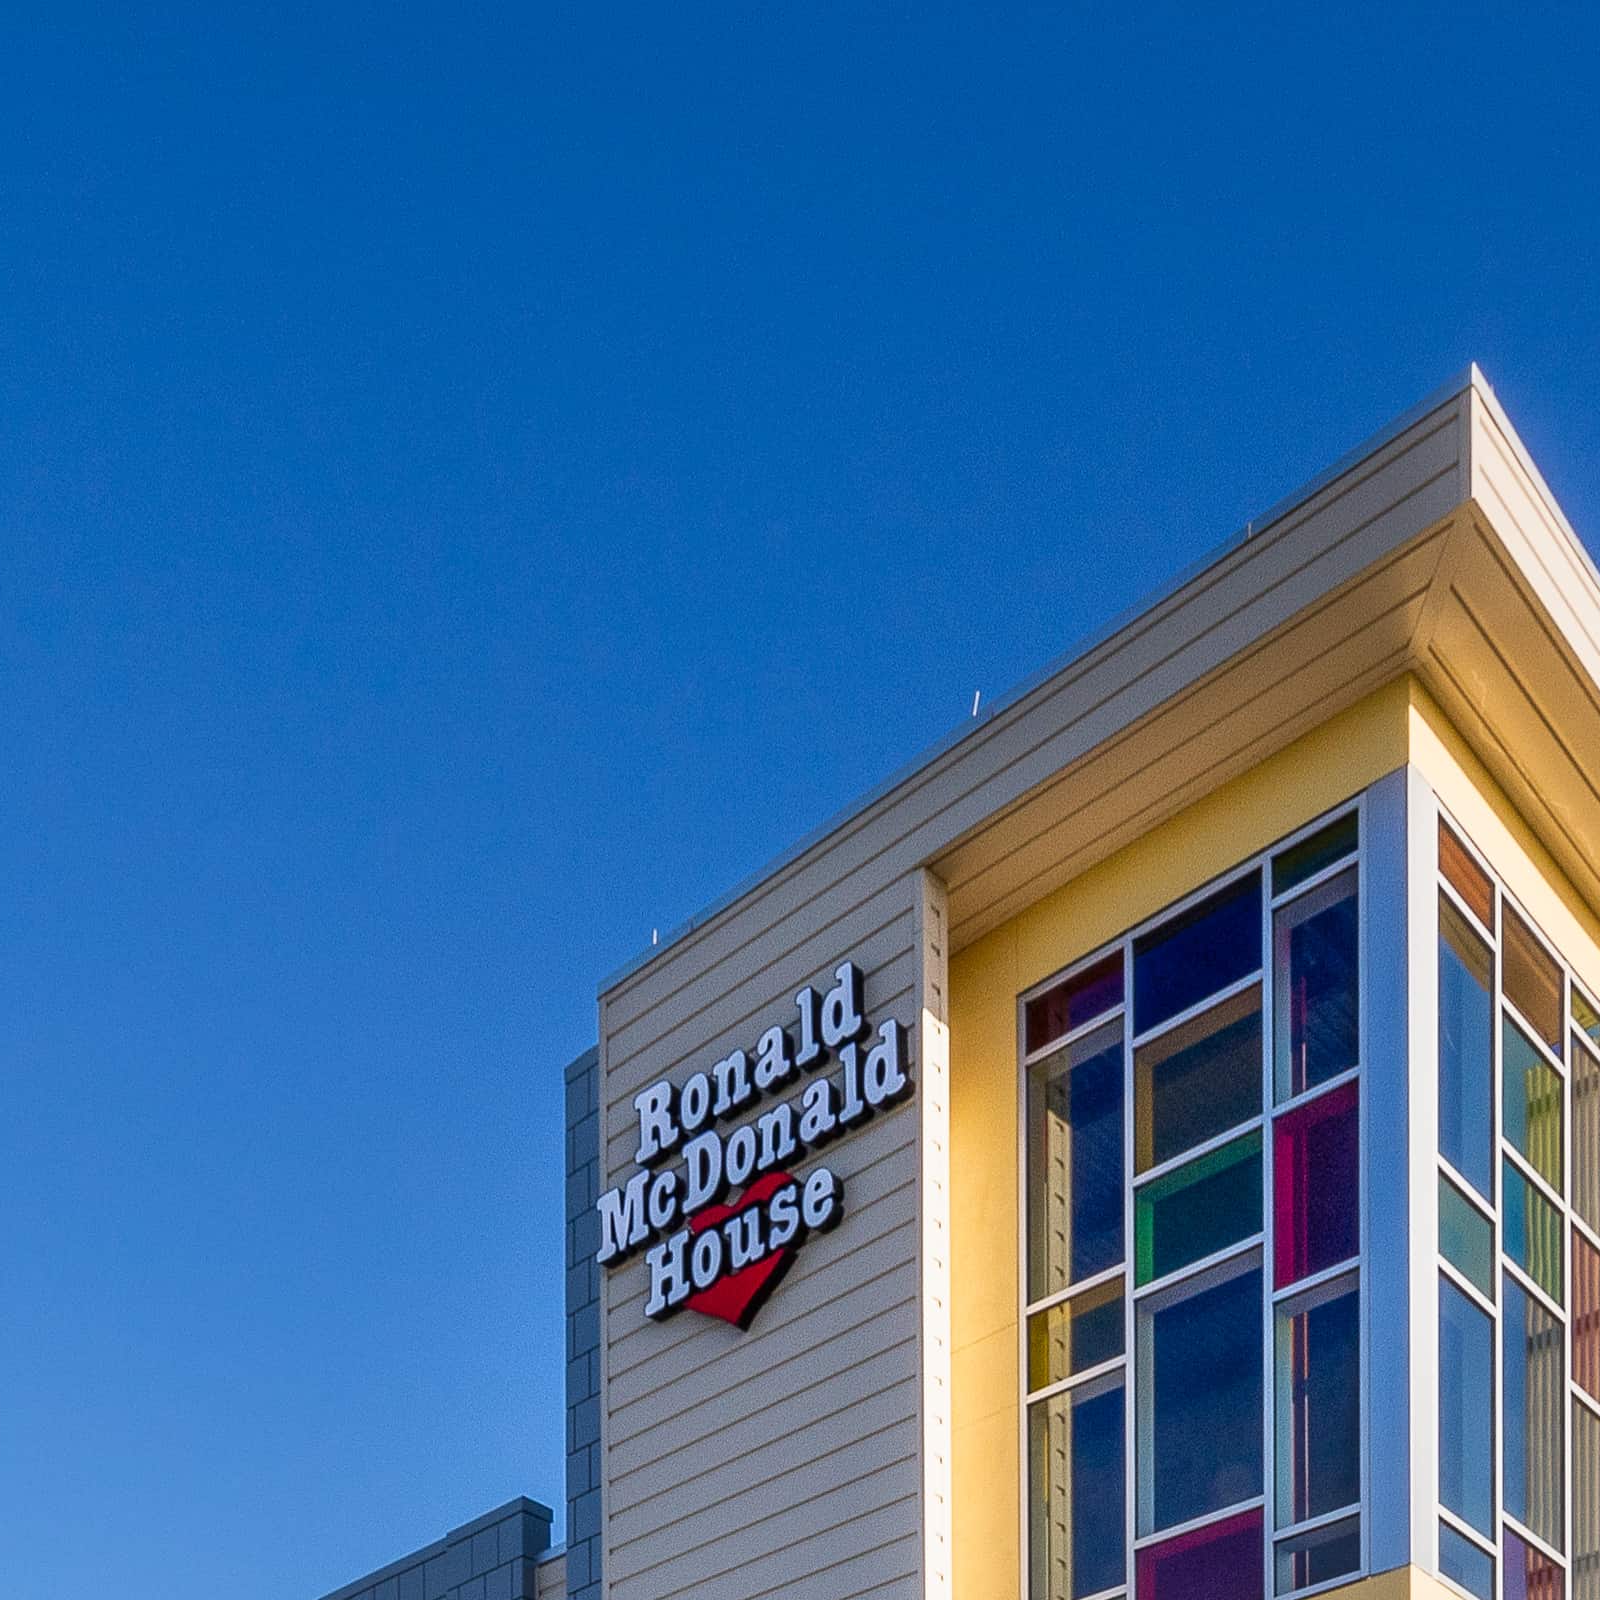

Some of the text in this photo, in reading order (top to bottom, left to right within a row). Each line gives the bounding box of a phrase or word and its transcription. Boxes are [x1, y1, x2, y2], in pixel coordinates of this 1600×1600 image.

[597, 1018, 907, 1264] McDonald
[634, 961, 863, 1164] Ronald
[645, 1168, 837, 1318] House
